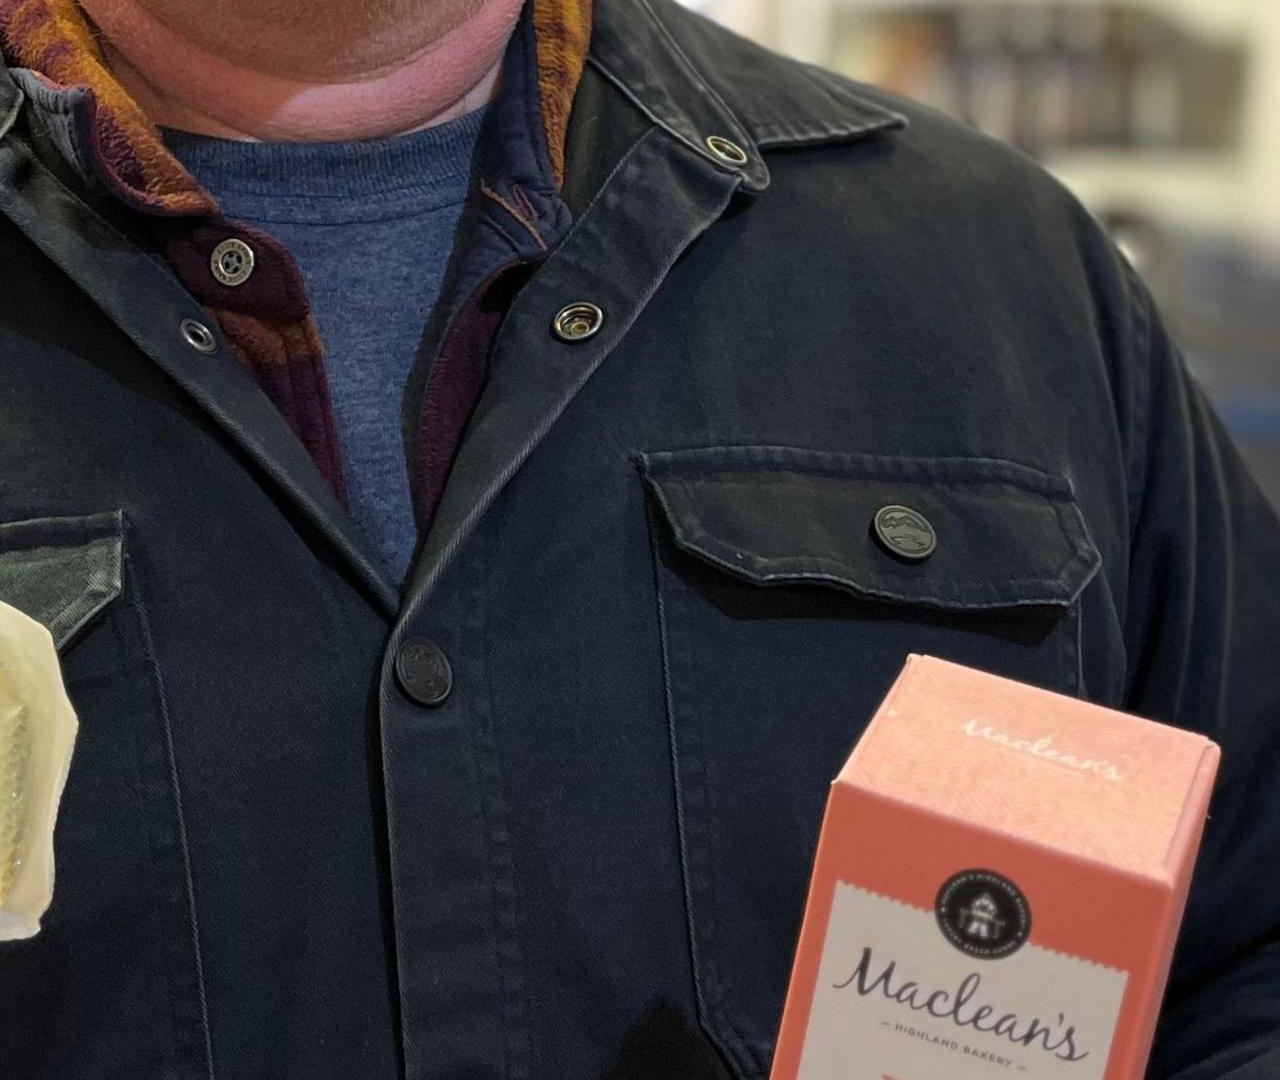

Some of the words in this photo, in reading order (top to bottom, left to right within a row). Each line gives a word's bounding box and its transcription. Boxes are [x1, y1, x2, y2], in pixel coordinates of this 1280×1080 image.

[963, 719, 1121, 783] Maclean's
[832, 946, 1090, 1061] Maclean's
[894, 1022, 959, 1051] HIGHLAND
[963, 1045, 1014, 1069] BAKERY
